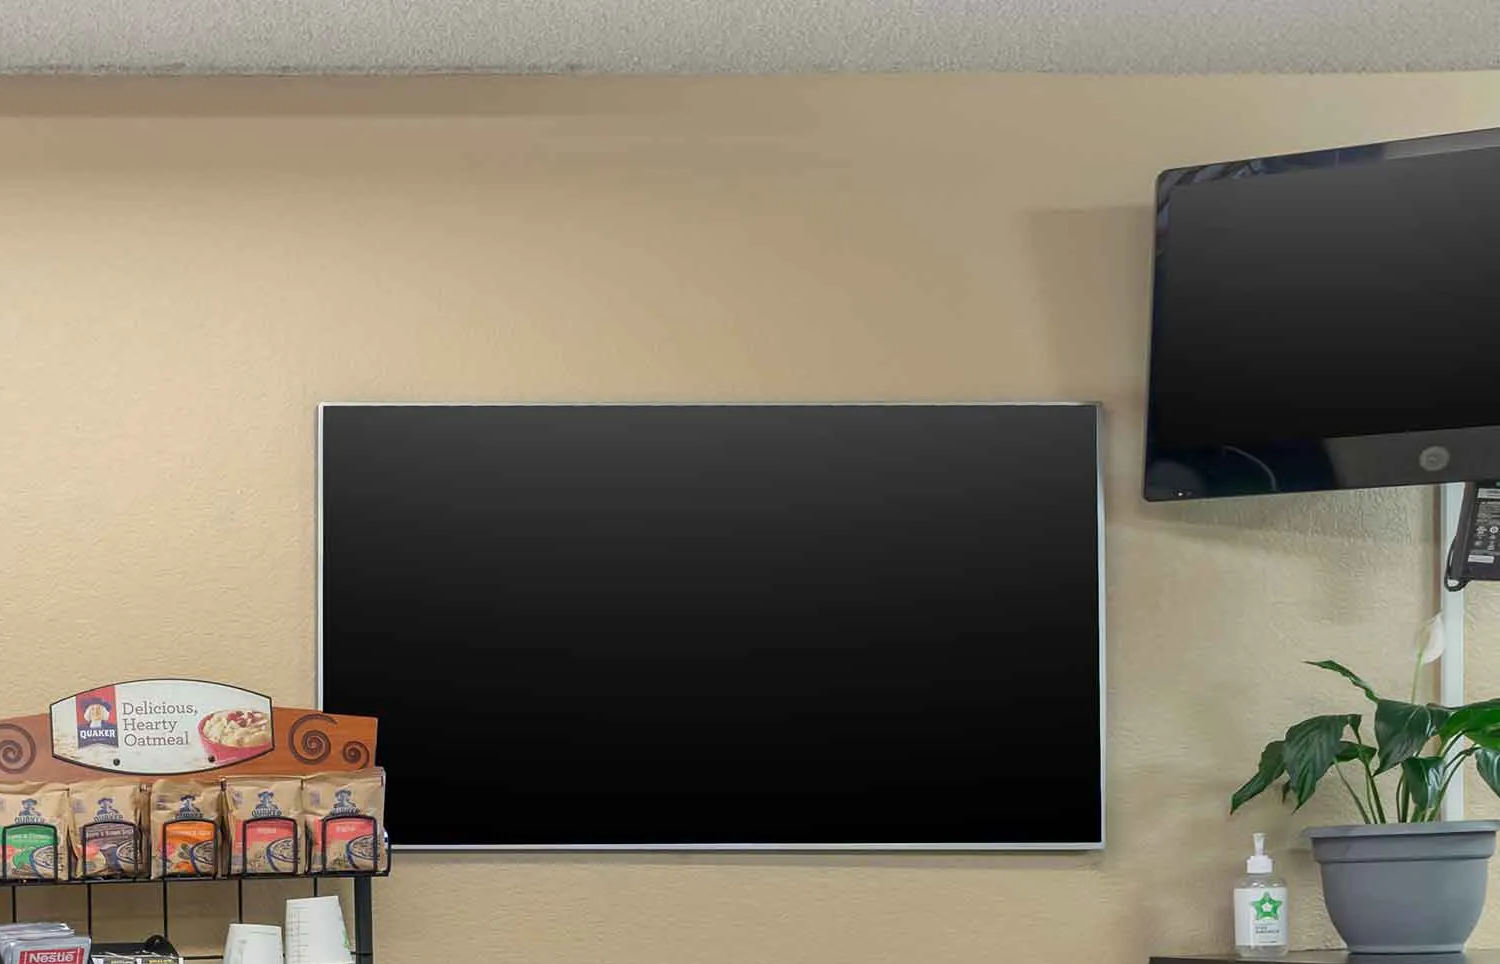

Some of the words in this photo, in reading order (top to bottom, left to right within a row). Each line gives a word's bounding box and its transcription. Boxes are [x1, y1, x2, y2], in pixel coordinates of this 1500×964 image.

[122, 702, 199, 716] Delicious,
[123, 719, 178, 732] Hearty
[79, 729, 116, 739] QUAKER
[124, 731, 190, 747] Oatmeal
